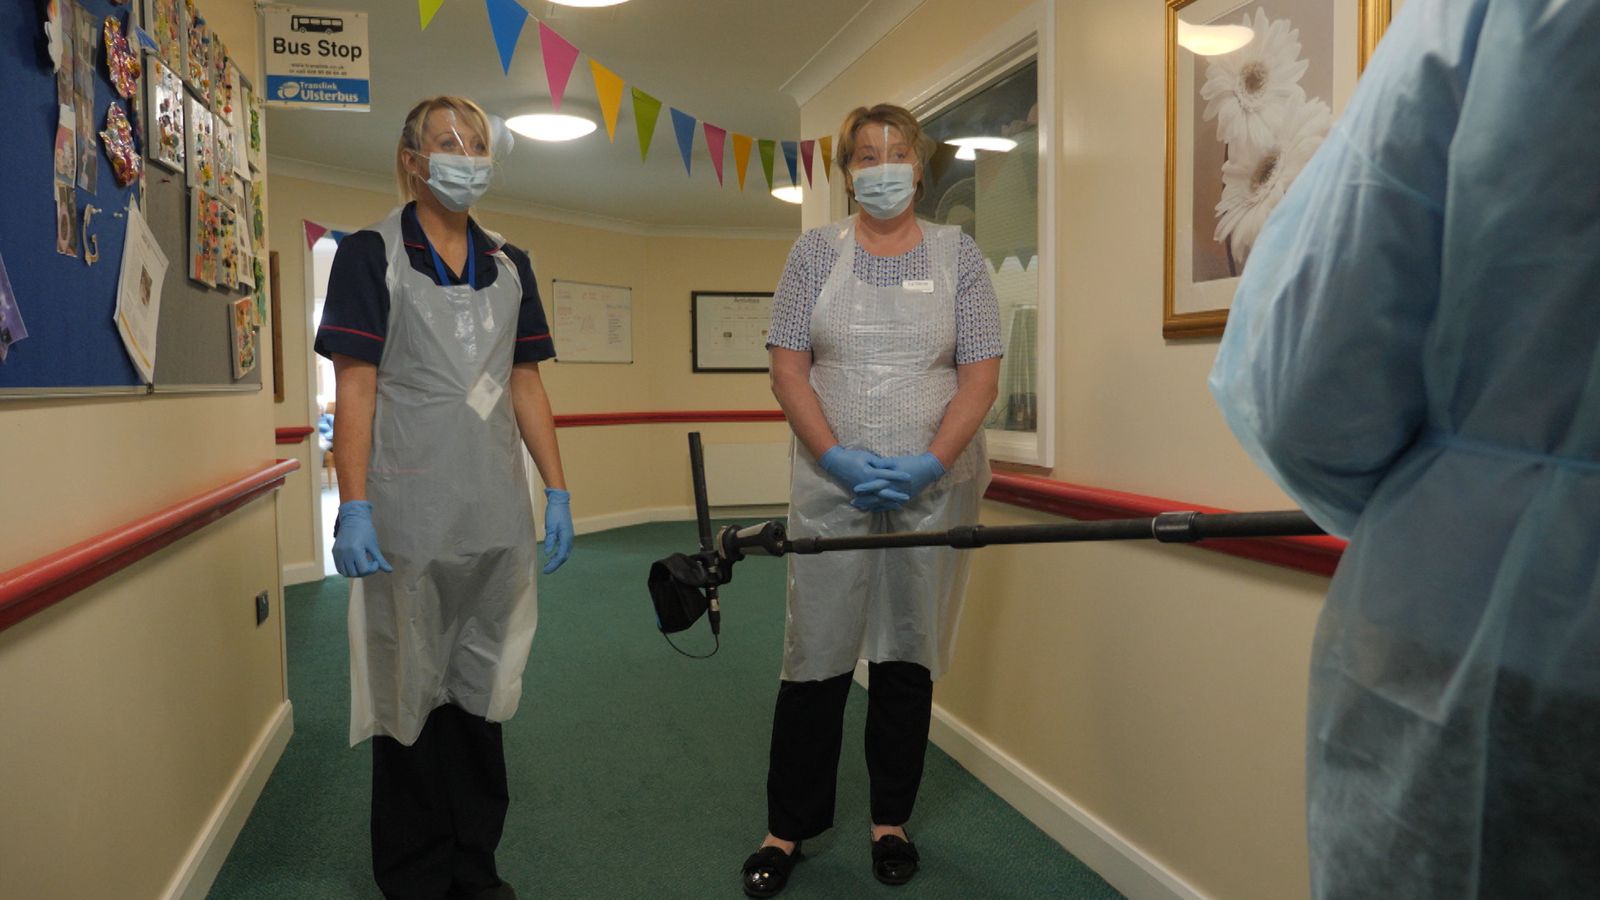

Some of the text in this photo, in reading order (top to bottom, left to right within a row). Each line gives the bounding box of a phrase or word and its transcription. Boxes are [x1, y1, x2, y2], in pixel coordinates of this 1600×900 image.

[273, 37, 362, 62] Bus Stop
[300, 81, 338, 89] Translink
[300, 90, 359, 103] Ulsterbus
